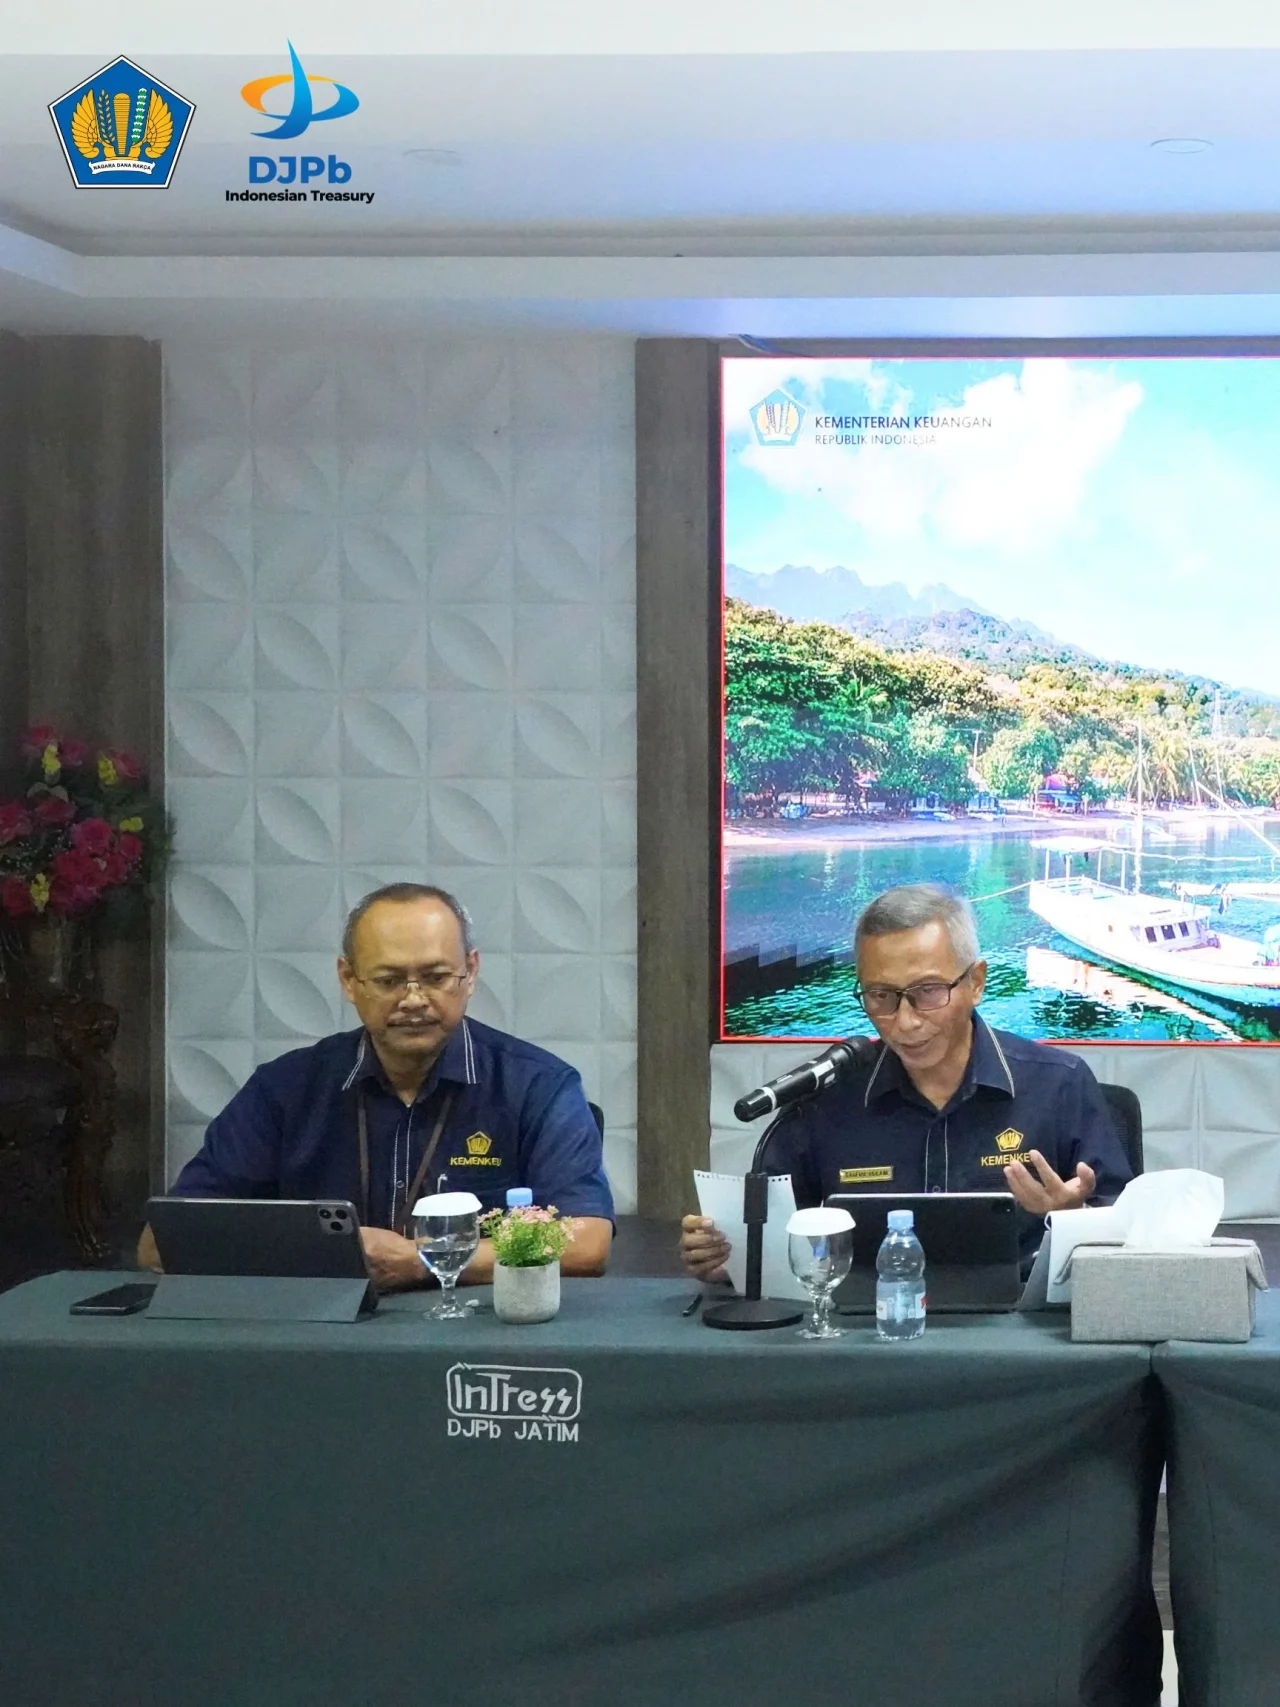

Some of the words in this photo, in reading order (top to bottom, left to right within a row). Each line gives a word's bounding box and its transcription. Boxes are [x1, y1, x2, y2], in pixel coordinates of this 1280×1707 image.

[814, 416, 911, 429] KEMENTERIAN
[914, 416, 992, 428] KEUANGAN
[814, 434, 868, 445] REPUBLIK
[871, 434, 937, 445] INDONESIA
[981, 1152, 1031, 1167] KEMENKE
[447, 1418, 502, 1439] DJPb
[514, 1420, 579, 1442] JATIM
